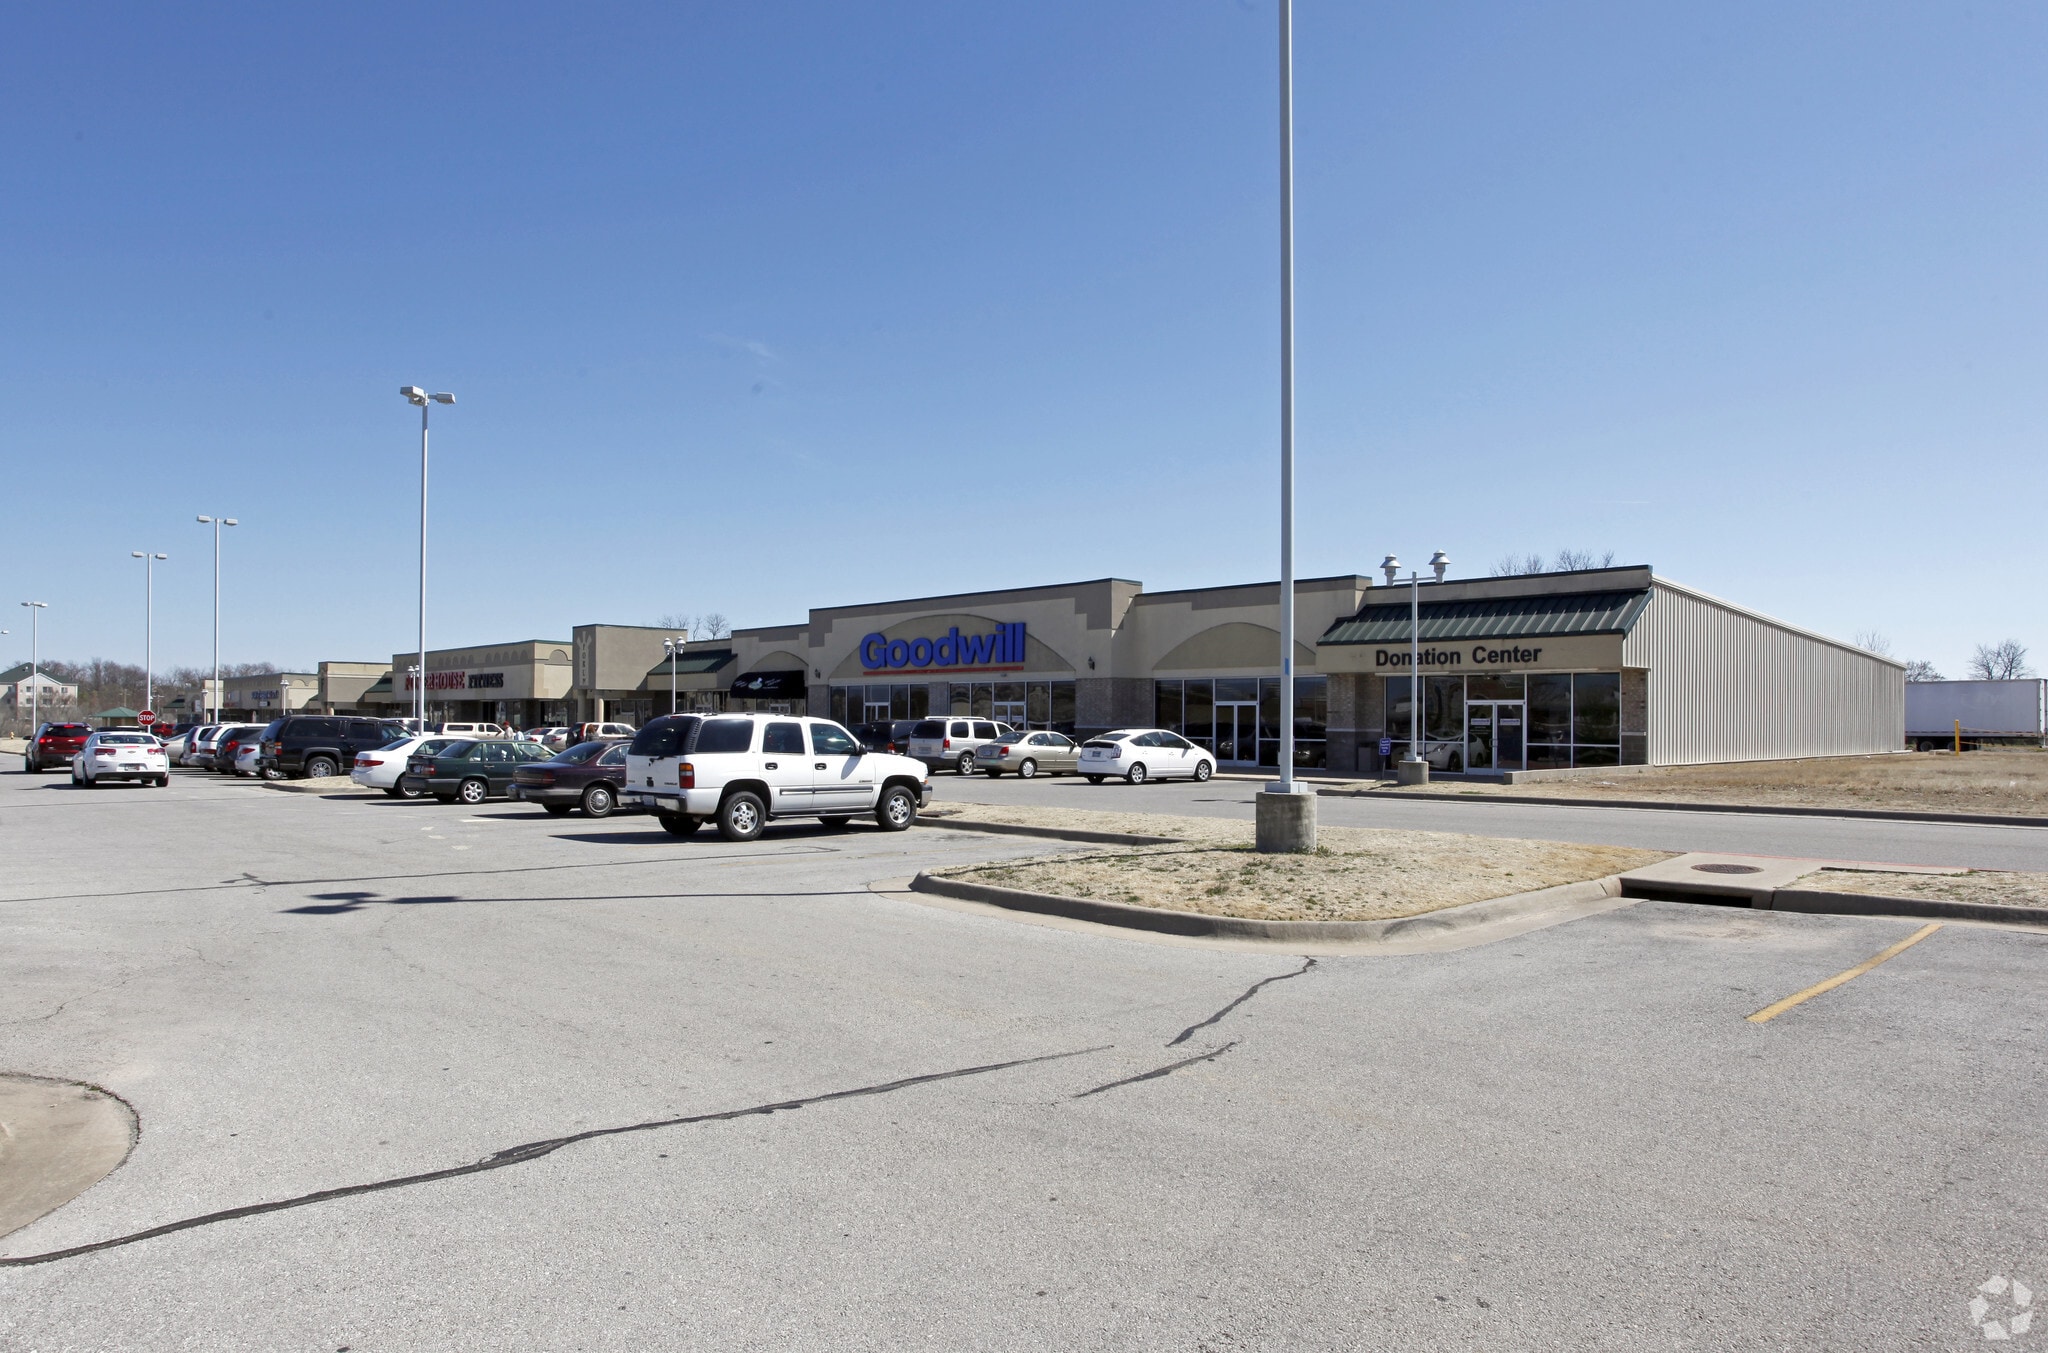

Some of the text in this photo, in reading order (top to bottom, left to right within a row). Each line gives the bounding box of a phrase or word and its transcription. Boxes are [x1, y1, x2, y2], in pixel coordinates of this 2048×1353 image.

[860, 622, 1026, 669] Goodwill
[1375, 645, 1542, 666] Donation Center
